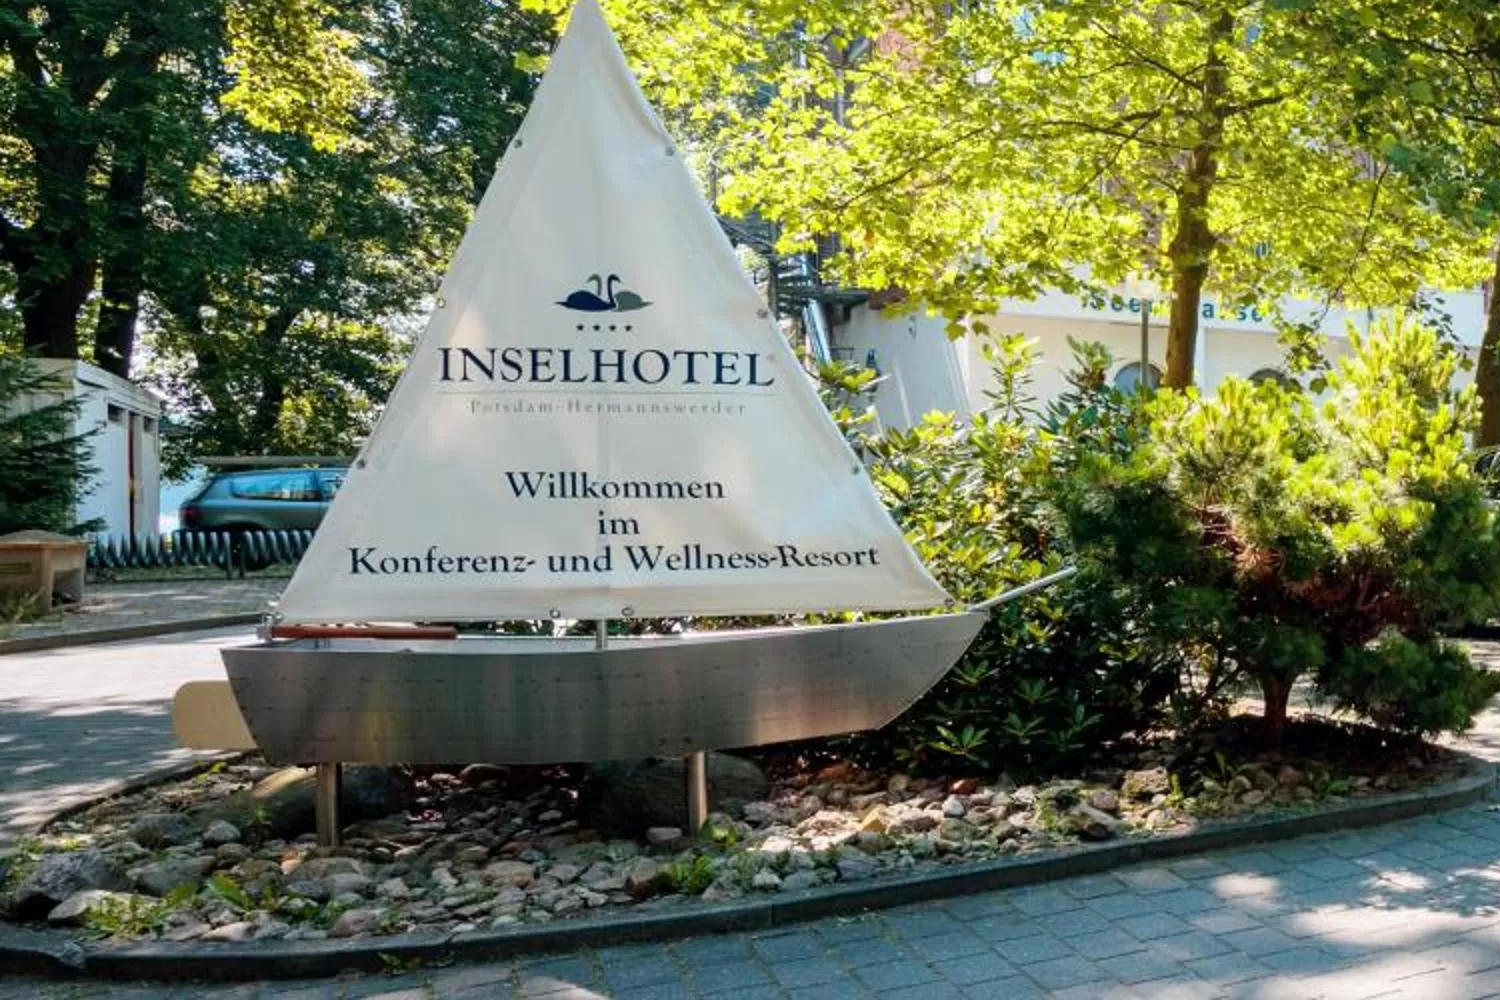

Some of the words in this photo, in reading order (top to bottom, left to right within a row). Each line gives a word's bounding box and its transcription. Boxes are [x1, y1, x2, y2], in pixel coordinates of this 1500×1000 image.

[438, 347, 775, 387] INSELHOTEL
[505, 471, 724, 499] Willkommen
[598, 509, 640, 535] im
[348, 545, 536, 574] Konferenz-
[547, 545, 613, 573] und
[624, 543, 880, 571] Wellness-Resort
